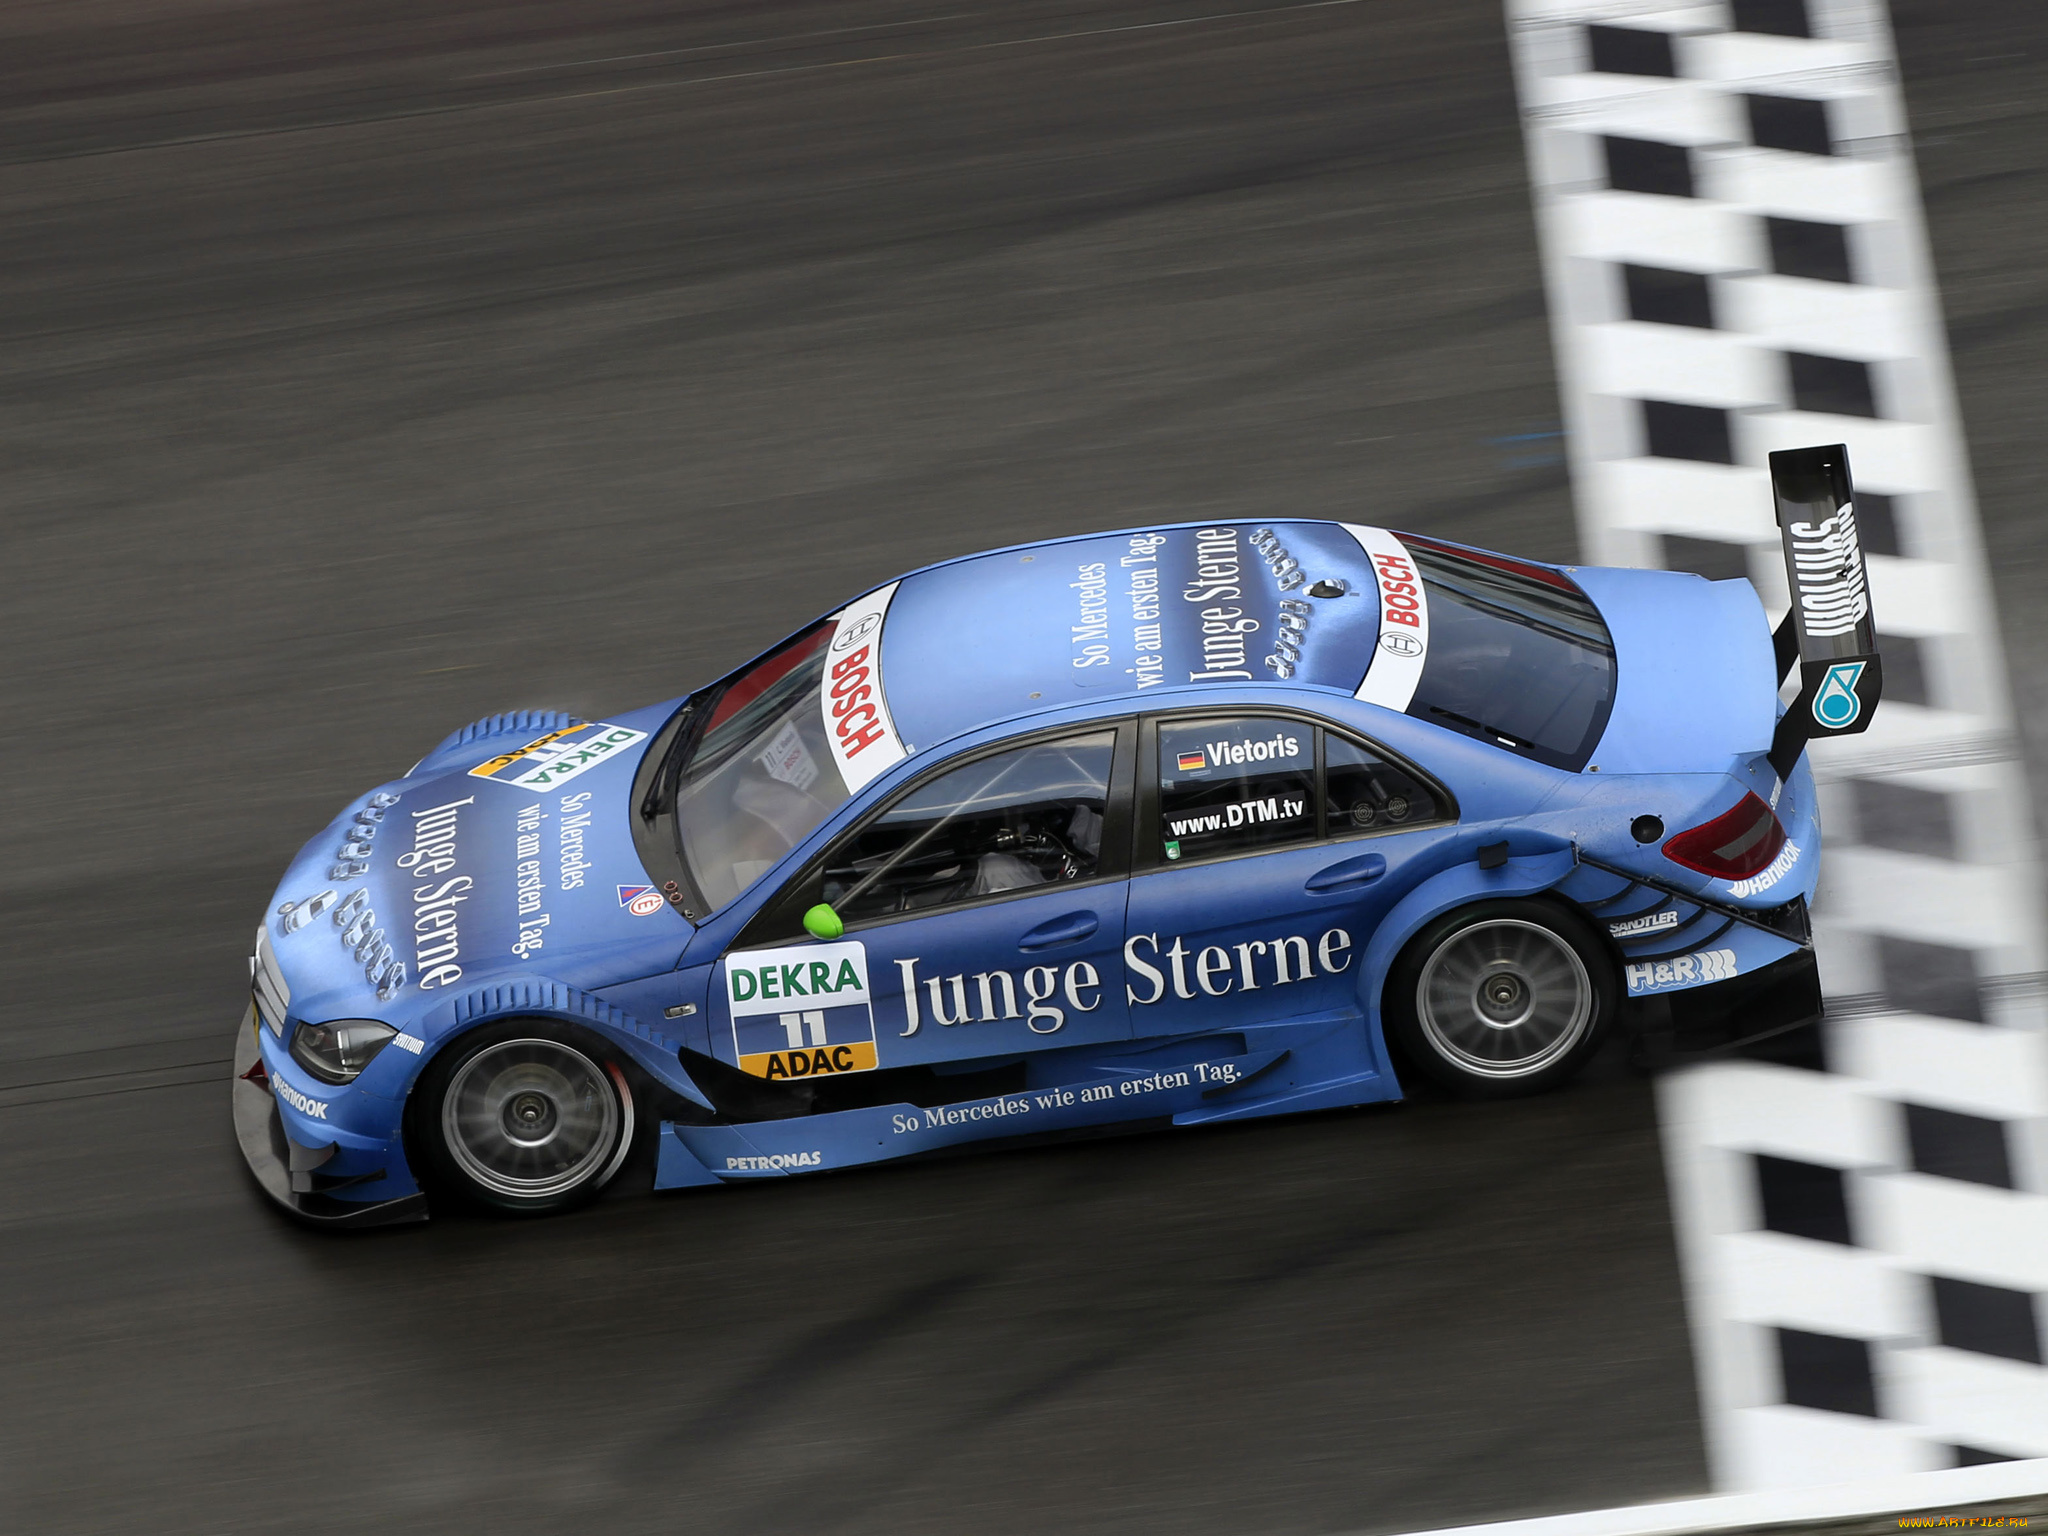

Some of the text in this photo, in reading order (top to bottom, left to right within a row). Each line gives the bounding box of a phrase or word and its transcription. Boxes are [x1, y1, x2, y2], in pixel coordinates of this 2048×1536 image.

[1069, 562, 1110, 668] So Mercedes
[1124, 567, 1160, 621] ersten
[1183, 528, 1260, 682] Junge Sterne
[1373, 553, 1420, 628] BOSCH
[1133, 622, 1162, 651] am
[1125, 654, 1165, 690] wie
[830, 643, 885, 760] BOSCH
[522, 730, 637, 784] DEKRA
[1206, 733, 1300, 767] Vietoris
[560, 792, 592, 890] So Mercedes
[1170, 798, 1304, 837] www.DTM.tv
[396, 795, 475, 990] Junge Sterne
[511, 803, 551, 960] wie am ersten Tag.
[1609, 910, 1678, 933] SANDTLER
[731, 958, 863, 1002] DEKRA
[894, 927, 1353, 1034] Junge Sterne
[1627, 954, 1699, 990] H&R
[779, 1010, 827, 1048] 11
[766, 1046, 854, 1080] ADAC
[893, 1062, 1242, 1135] So Mercedes wie am ersten Tag.
[726, 1151, 821, 1170] PETRONAS
